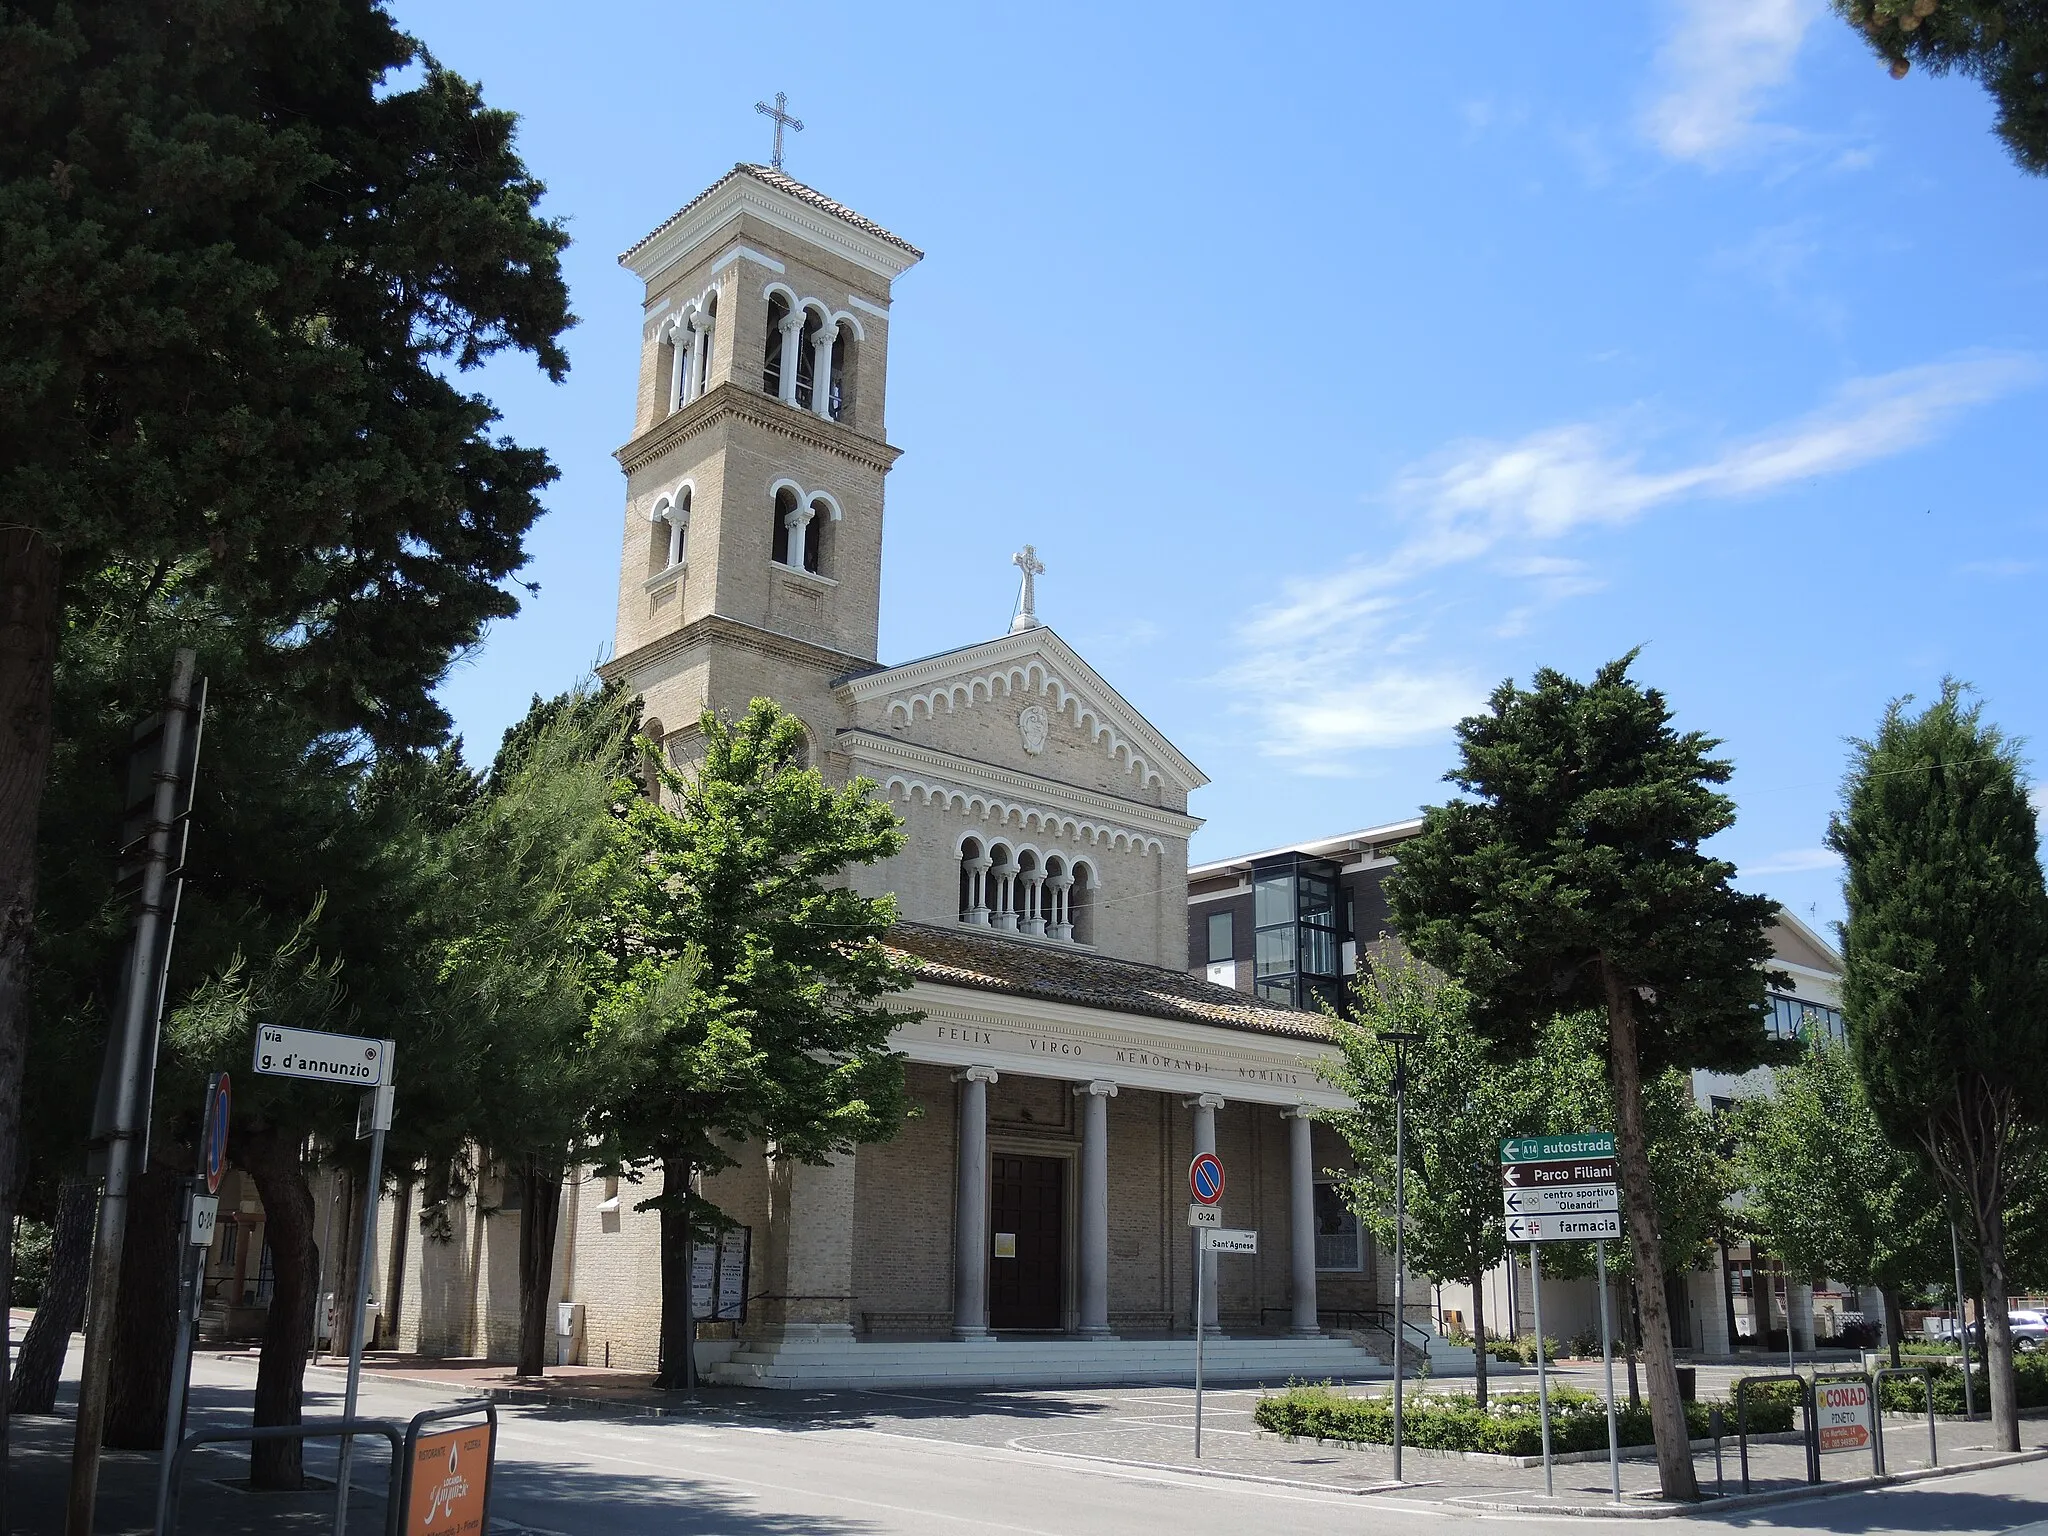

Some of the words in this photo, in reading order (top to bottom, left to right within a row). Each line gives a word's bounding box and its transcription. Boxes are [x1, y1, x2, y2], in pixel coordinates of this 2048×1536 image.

[264, 1030, 282, 1043] via
[938, 1026, 991, 1045] FELIX
[1029, 1039, 1082, 1056] VIRGO
[1116, 1051, 1209, 1073] MEMORANDI
[1239, 1067, 1298, 1084] NOMINIS
[261, 1054, 277, 1070] g.
[282, 1053, 370, 1078] d'annunzio
[1543, 1138, 1612, 1154] autostrada
[1534, 1169, 1569, 1181] Parco
[1574, 1164, 1613, 1179] Filiani
[1543, 1190, 1573, 1199] centro
[1576, 1188, 1615, 1199] sportivo
[1555, 1198, 1603, 1210] "Oleandri"
[198, 1210, 214, 1229] 0-24
[1198, 1212, 1215, 1222] 0-24
[1559, 1219, 1617, 1233] farmacia
[1212, 1239, 1254, 1250] Sant'Agnese
[1826, 1387, 1866, 1408] CONAD
[1831, 1411, 1856, 1424] PINETO
[418, 1446, 446, 1461] RISTORANTE
